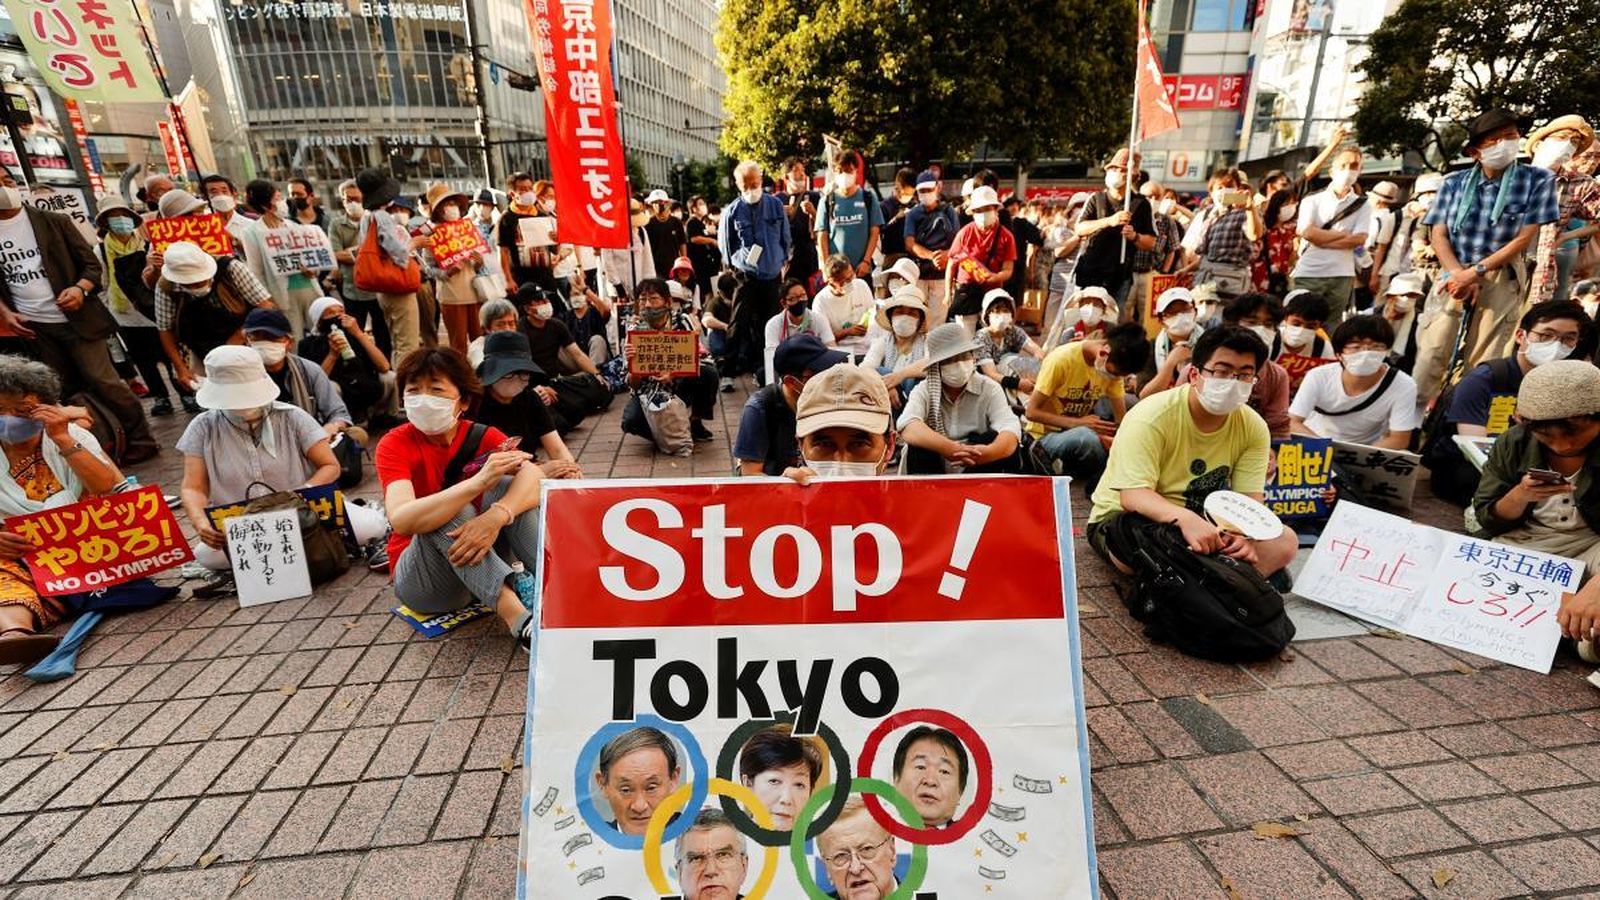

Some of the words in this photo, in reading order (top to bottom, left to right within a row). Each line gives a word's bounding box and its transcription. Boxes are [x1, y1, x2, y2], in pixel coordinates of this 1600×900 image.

[149, 215, 222, 240] オリンピック
[1278, 443, 1333, 486] 倒せ!
[15, 491, 159, 547] オリンピック
[1272, 501, 1316, 515] SUGA
[35, 519, 174, 577] やめろ!
[45, 576, 81, 592] NO
[84, 548, 186, 586] OLYMPICS
[1331, 537, 1415, 592] 中止
[1453, 541, 1573, 587] 東京五輪
[1480, 571, 1549, 603] 今すぐ
[593, 637, 900, 738] Tokyo
